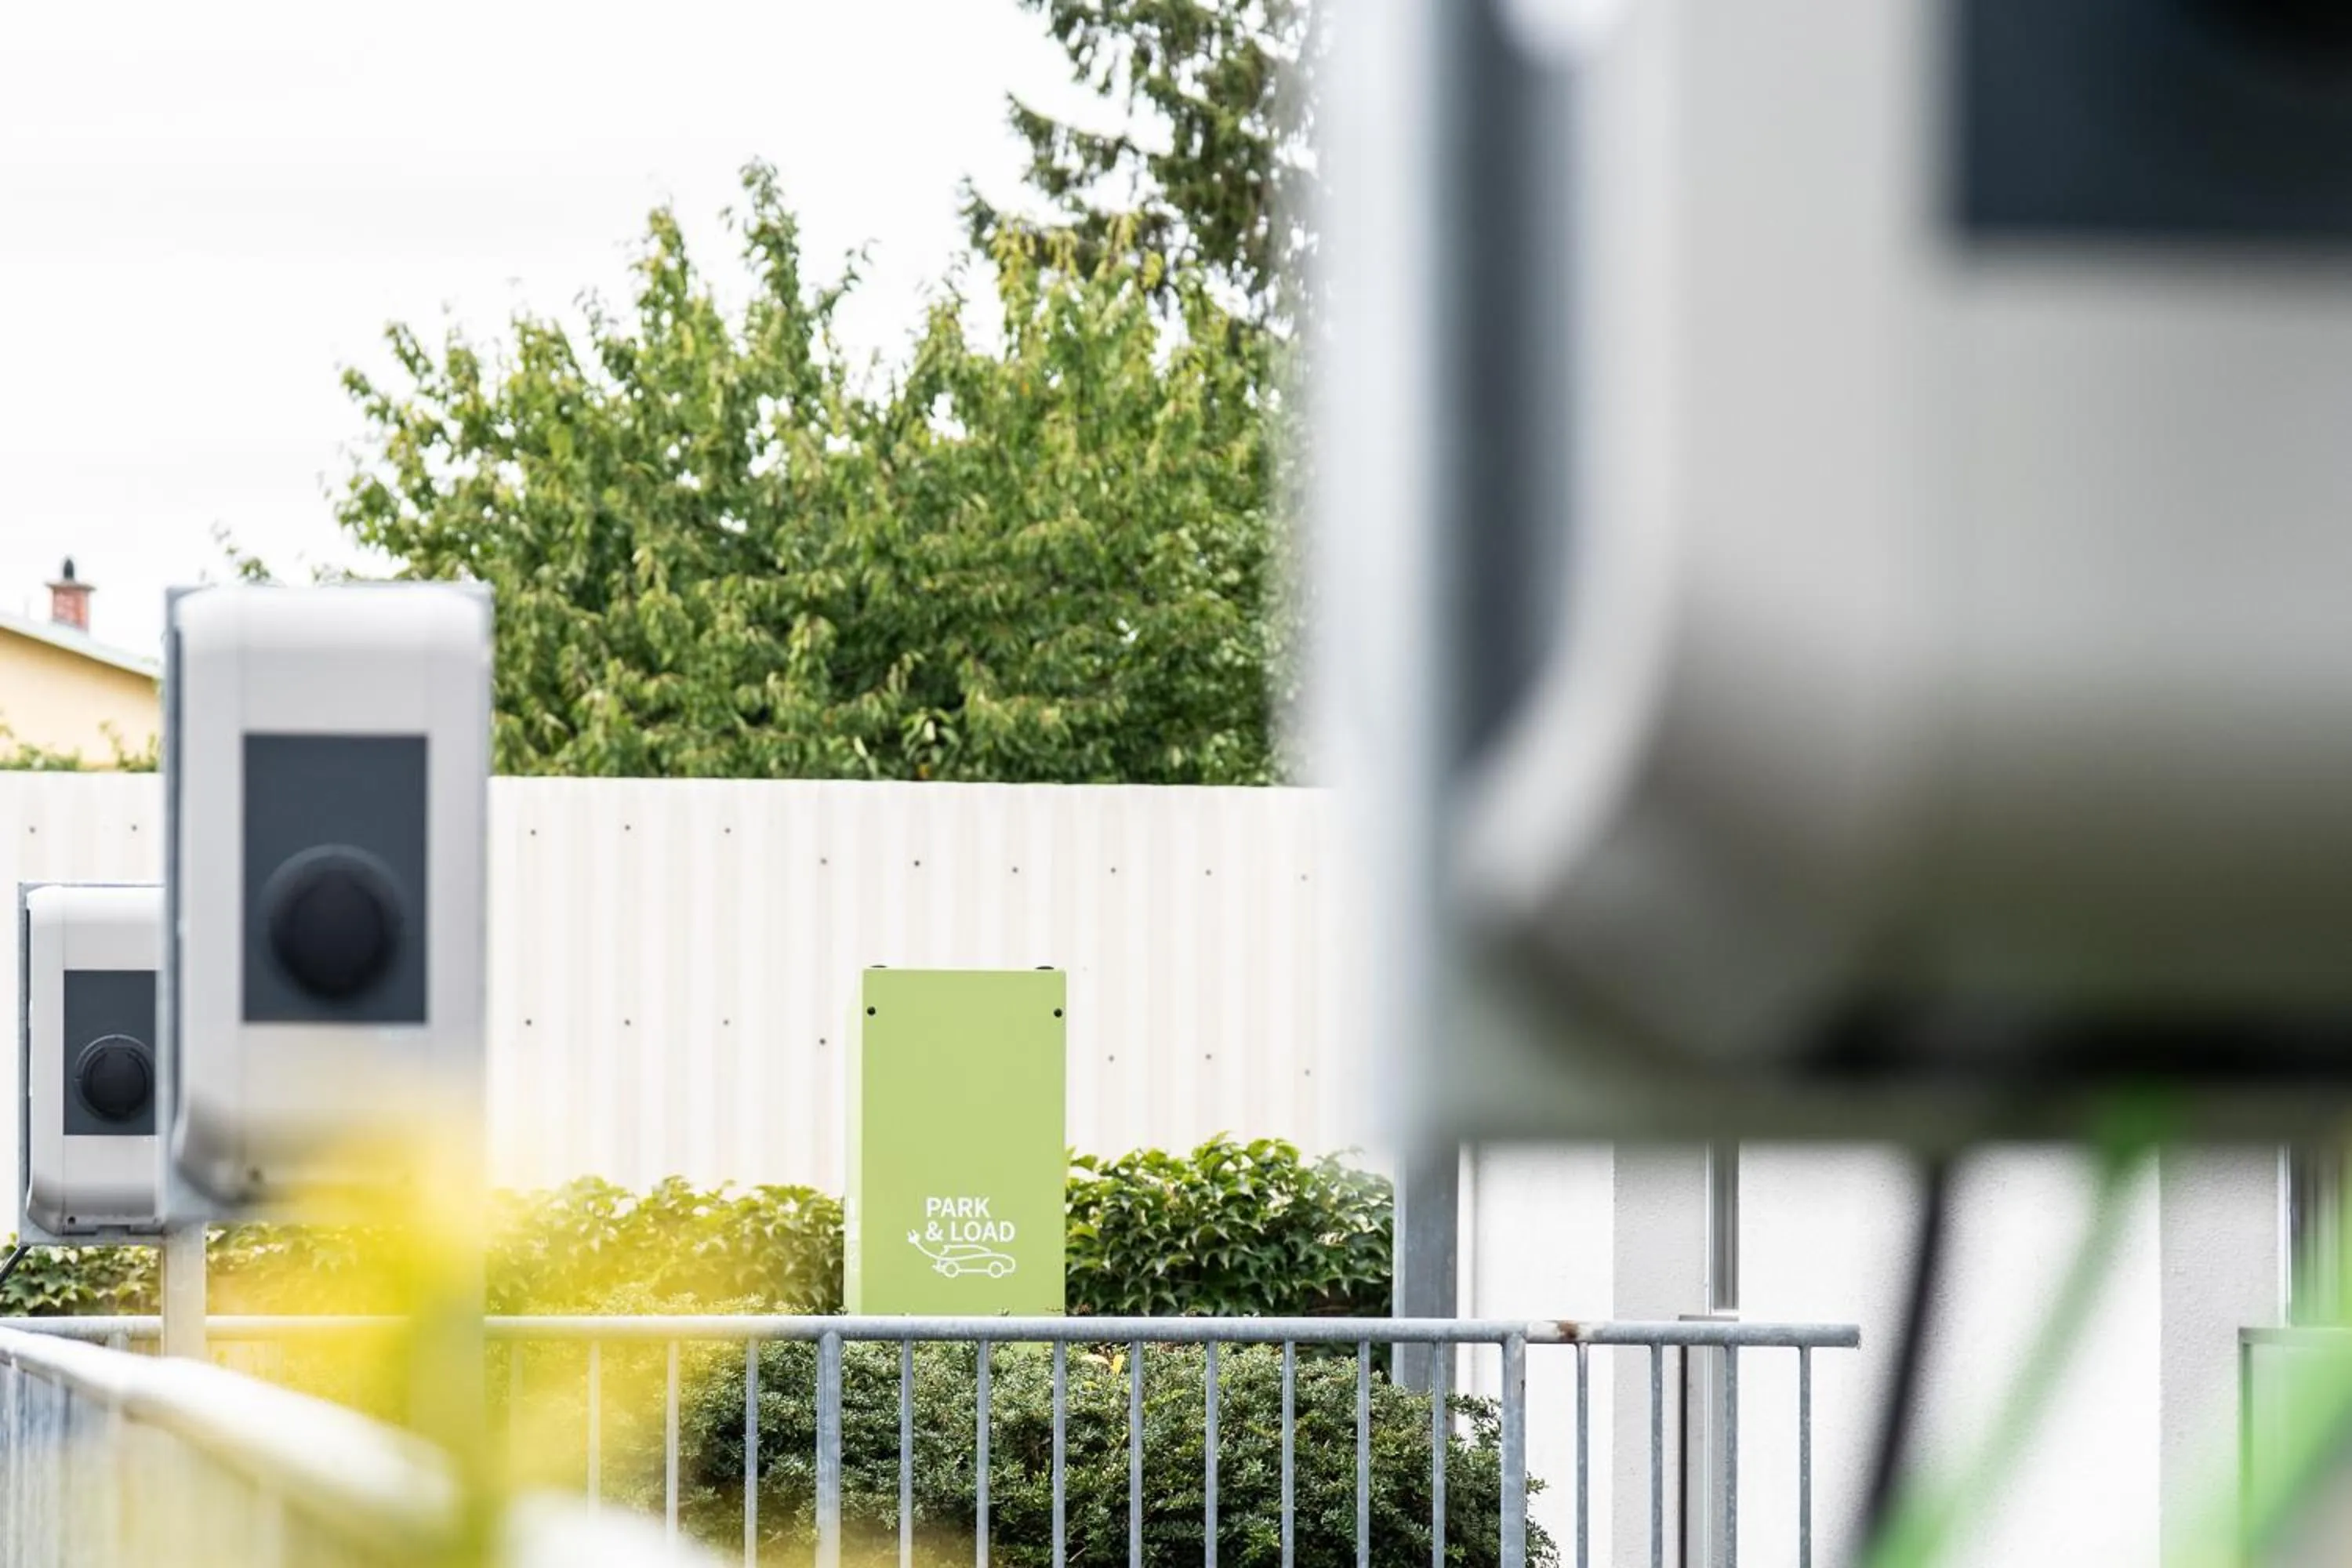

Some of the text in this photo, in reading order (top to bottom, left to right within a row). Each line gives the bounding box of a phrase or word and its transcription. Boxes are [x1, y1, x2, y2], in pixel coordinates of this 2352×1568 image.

[926, 1196, 991, 1218] PARK
[925, 1221, 1016, 1243] & LOAD
